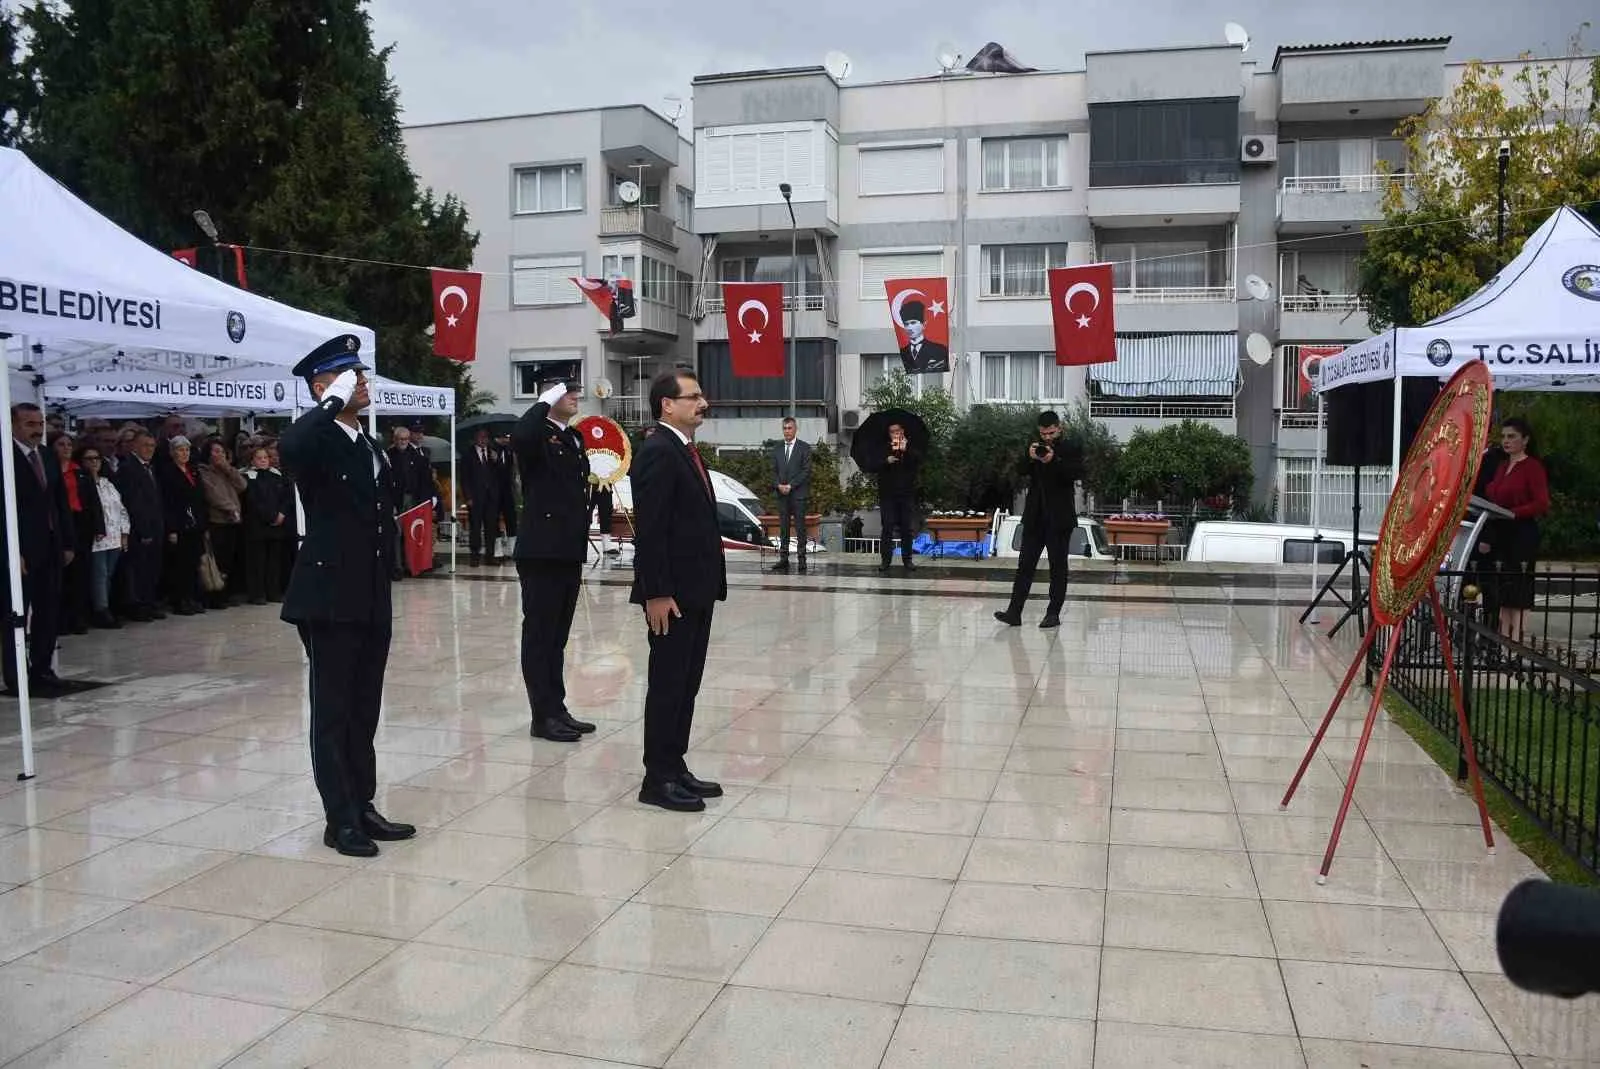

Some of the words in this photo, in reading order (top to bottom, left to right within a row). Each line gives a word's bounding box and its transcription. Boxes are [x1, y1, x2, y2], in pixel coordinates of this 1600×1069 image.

[0, 281, 161, 330] BELEDİYESİ
[188, 380, 266, 400] BELEDİYESİ
[384, 391, 435, 408] BELEDİYESİ
